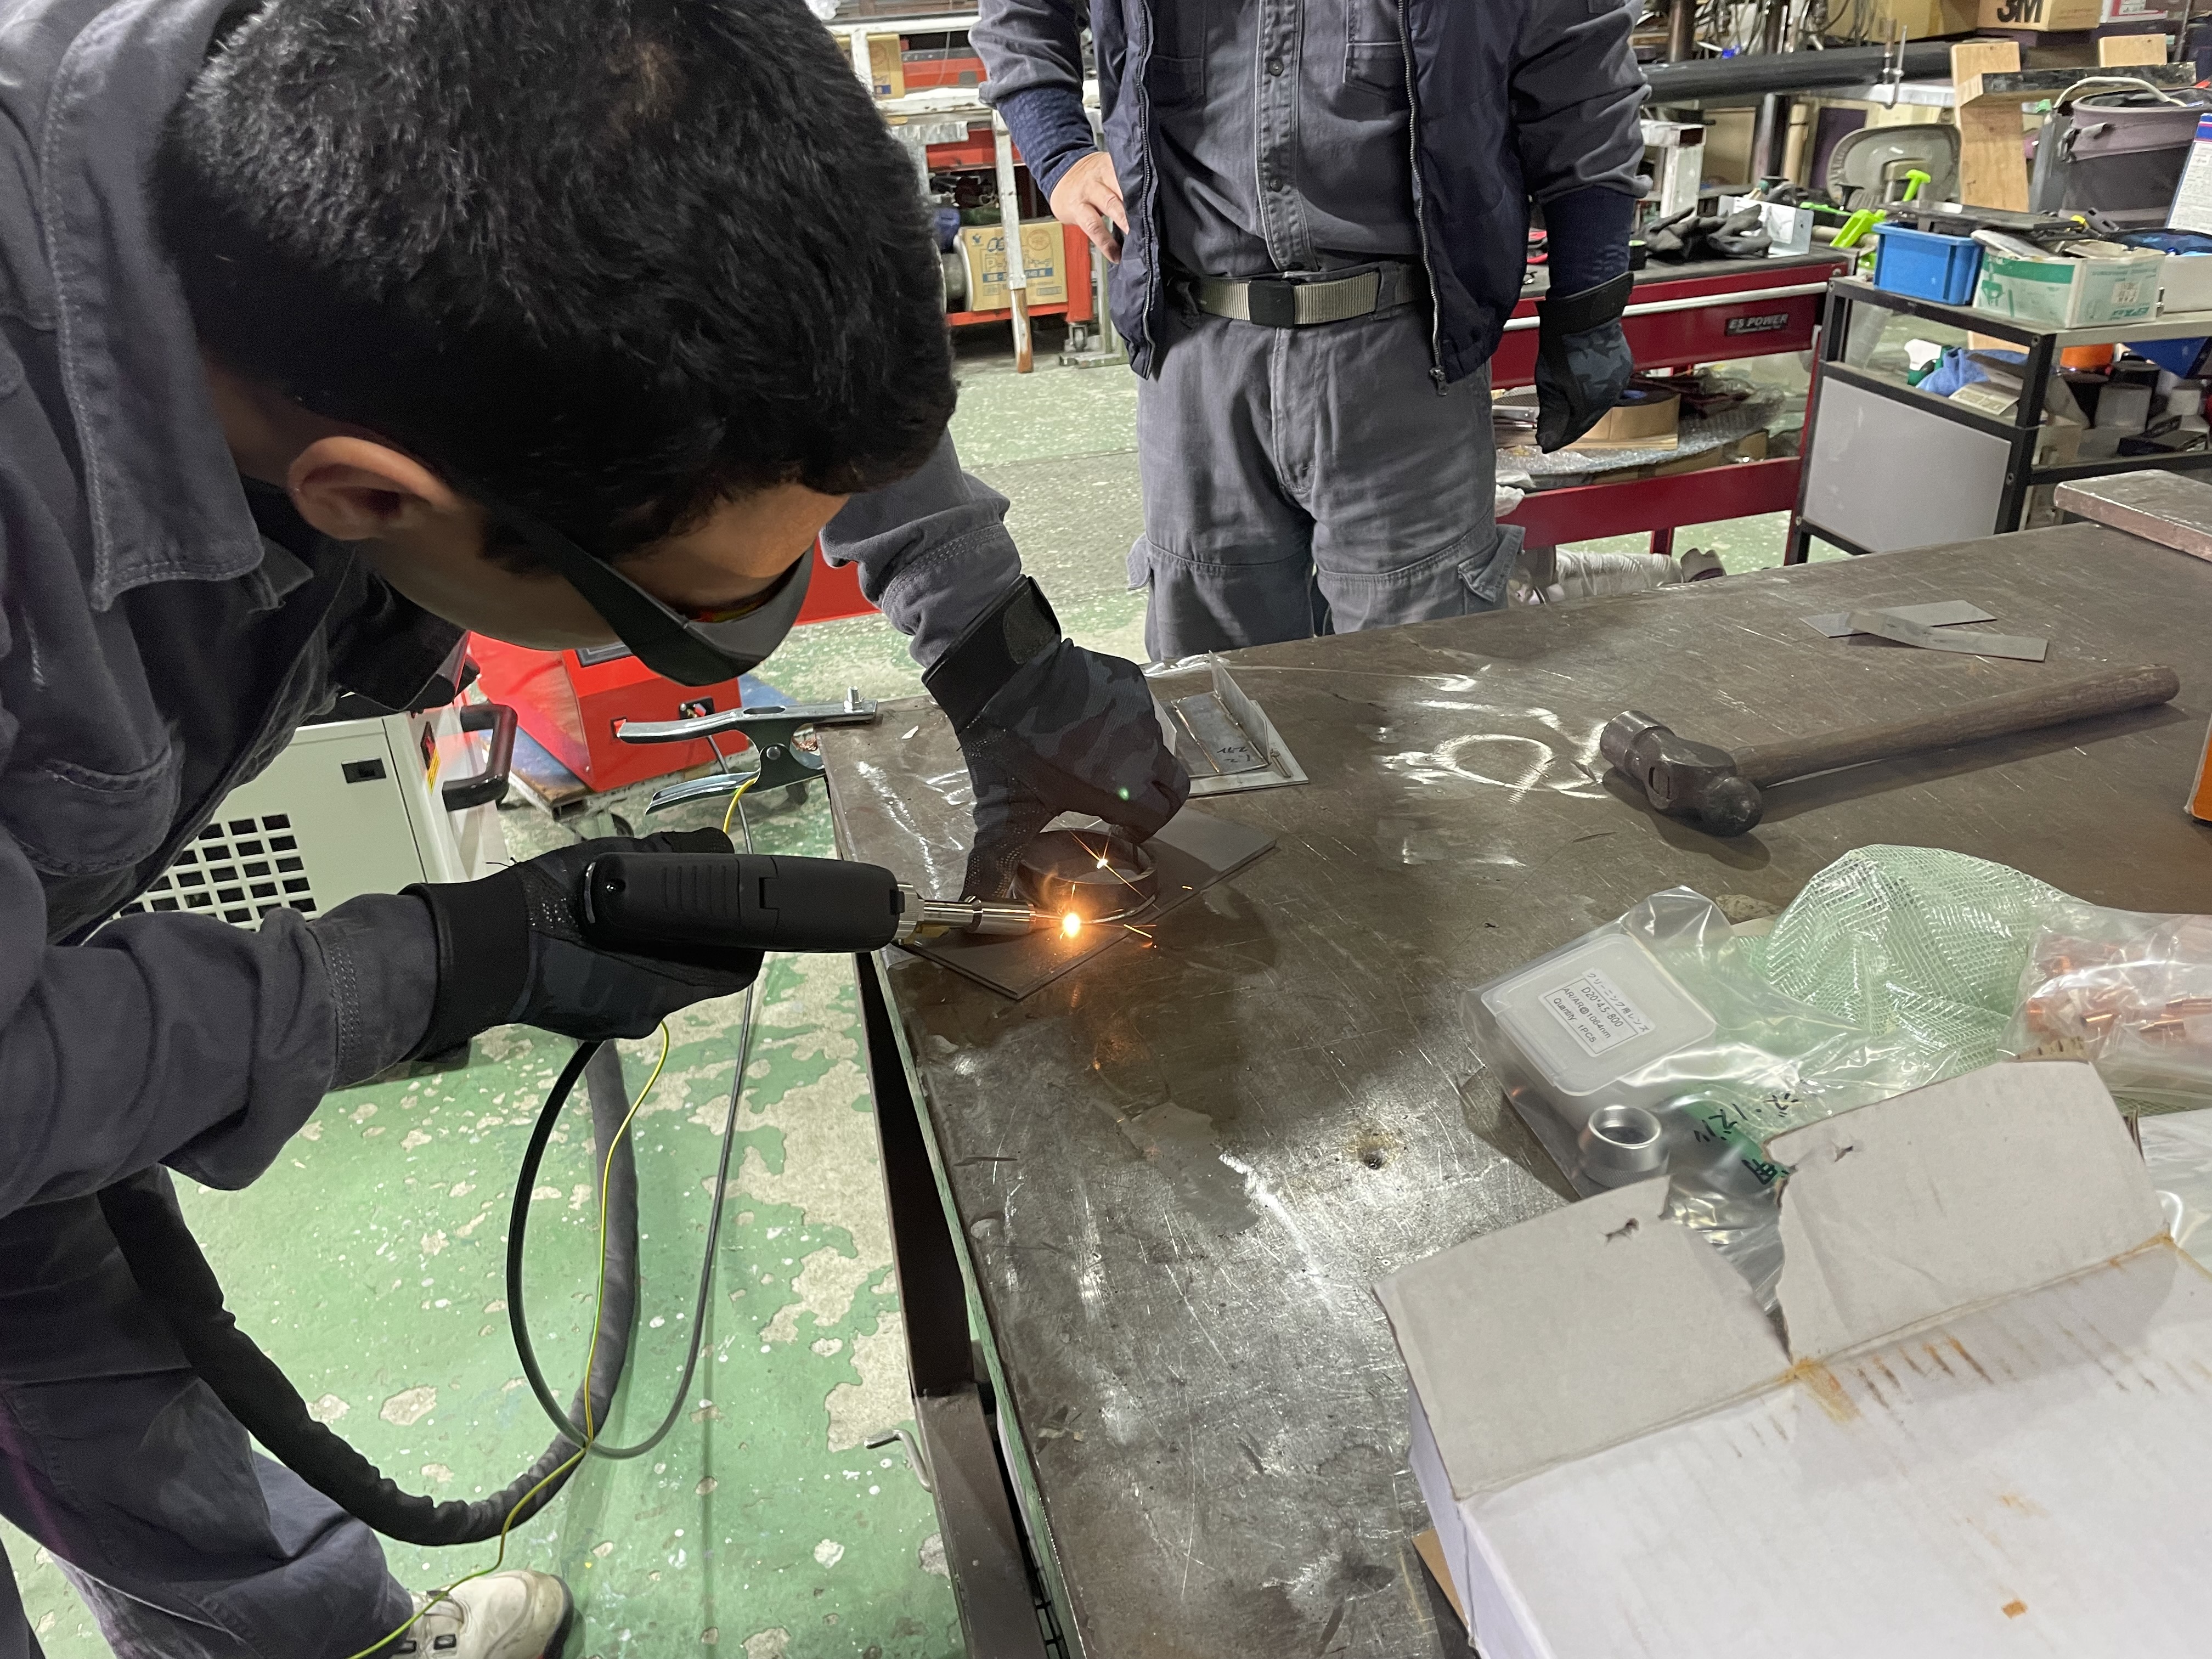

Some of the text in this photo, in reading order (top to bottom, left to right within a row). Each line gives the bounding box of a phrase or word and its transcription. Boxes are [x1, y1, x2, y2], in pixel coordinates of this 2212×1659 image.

[1997, 0, 2044, 23] 3M
[1746, 314, 1789, 326] POWER
[1562, 988, 1611, 1039] AR/AR@1064nm
[1587, 973, 1650, 1032] クリーニング用レンズ
